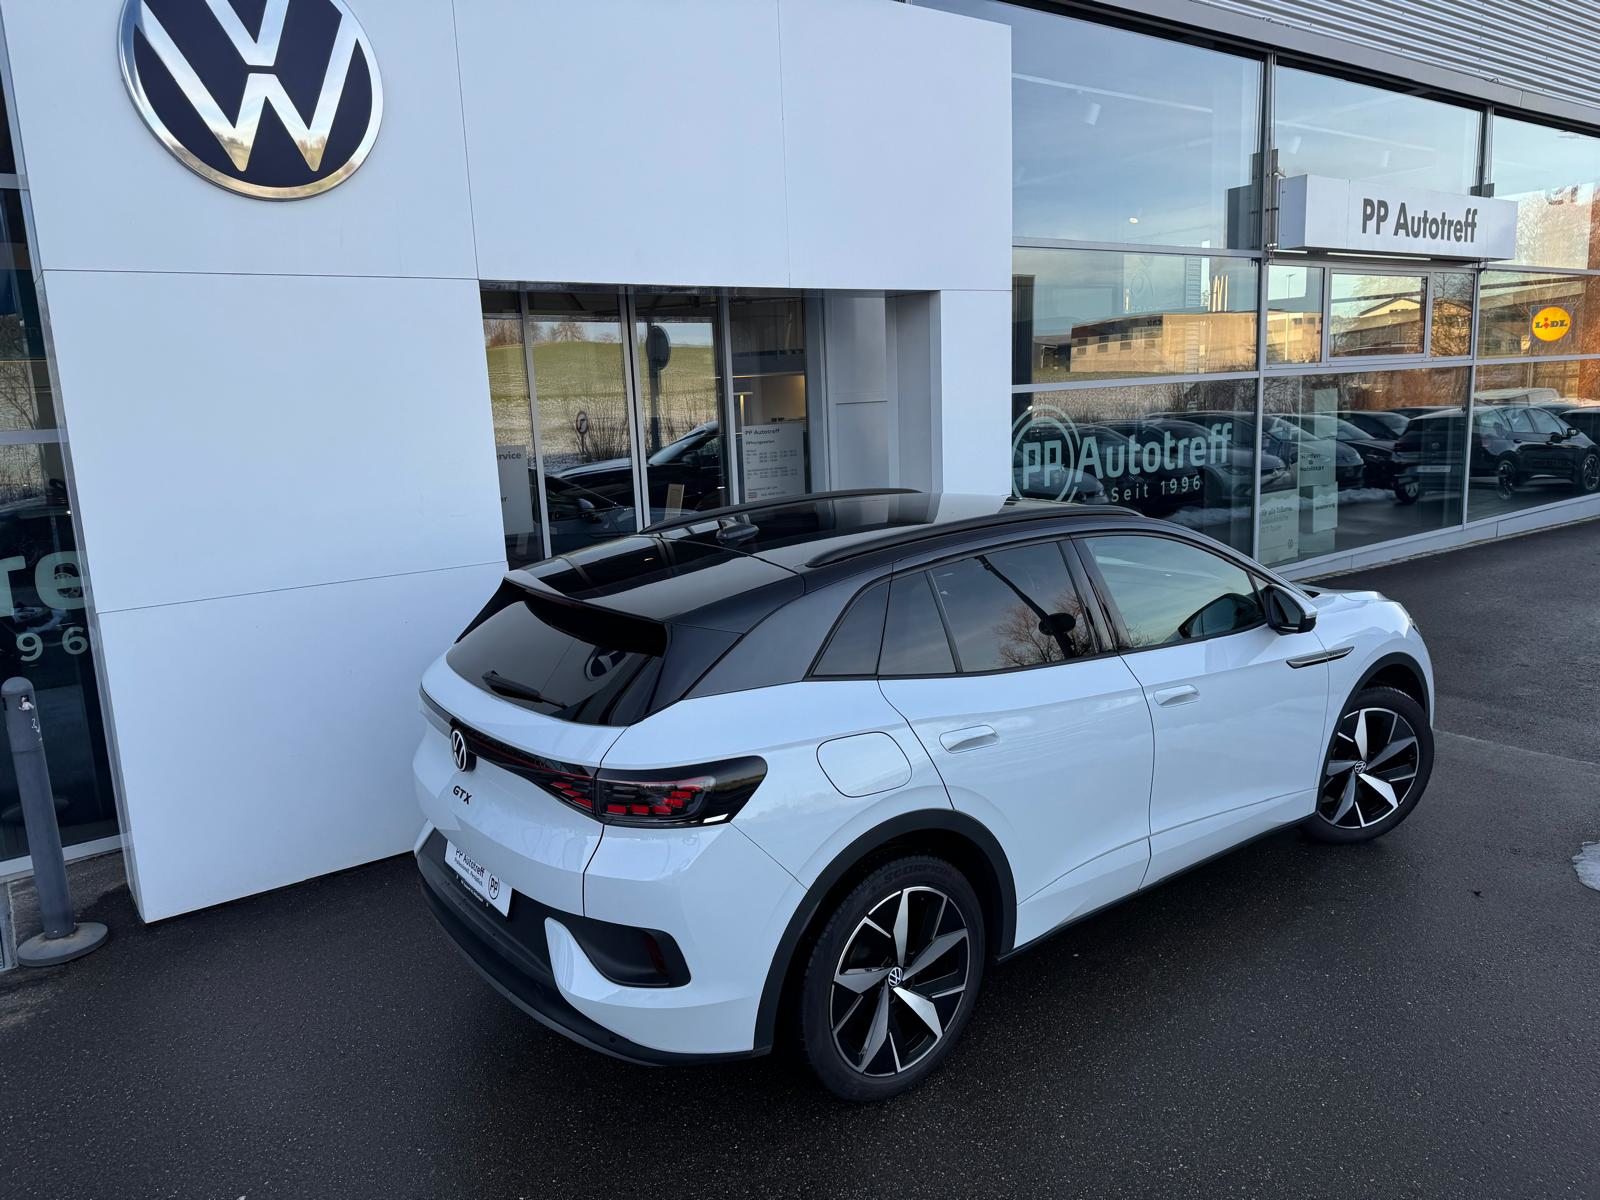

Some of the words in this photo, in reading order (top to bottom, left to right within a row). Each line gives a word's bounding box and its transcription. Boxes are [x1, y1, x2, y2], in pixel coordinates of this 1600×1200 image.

[1362, 198, 1389, 235] PP
[1393, 202, 1478, 243] Autotreff
[496, 450, 521, 460] rvice
[1074, 422, 1233, 483] Autotreff
[1111, 486, 1149, 502] Seit
[1160, 474, 1201, 496] 1996
[453, 785, 472, 804] GTX
